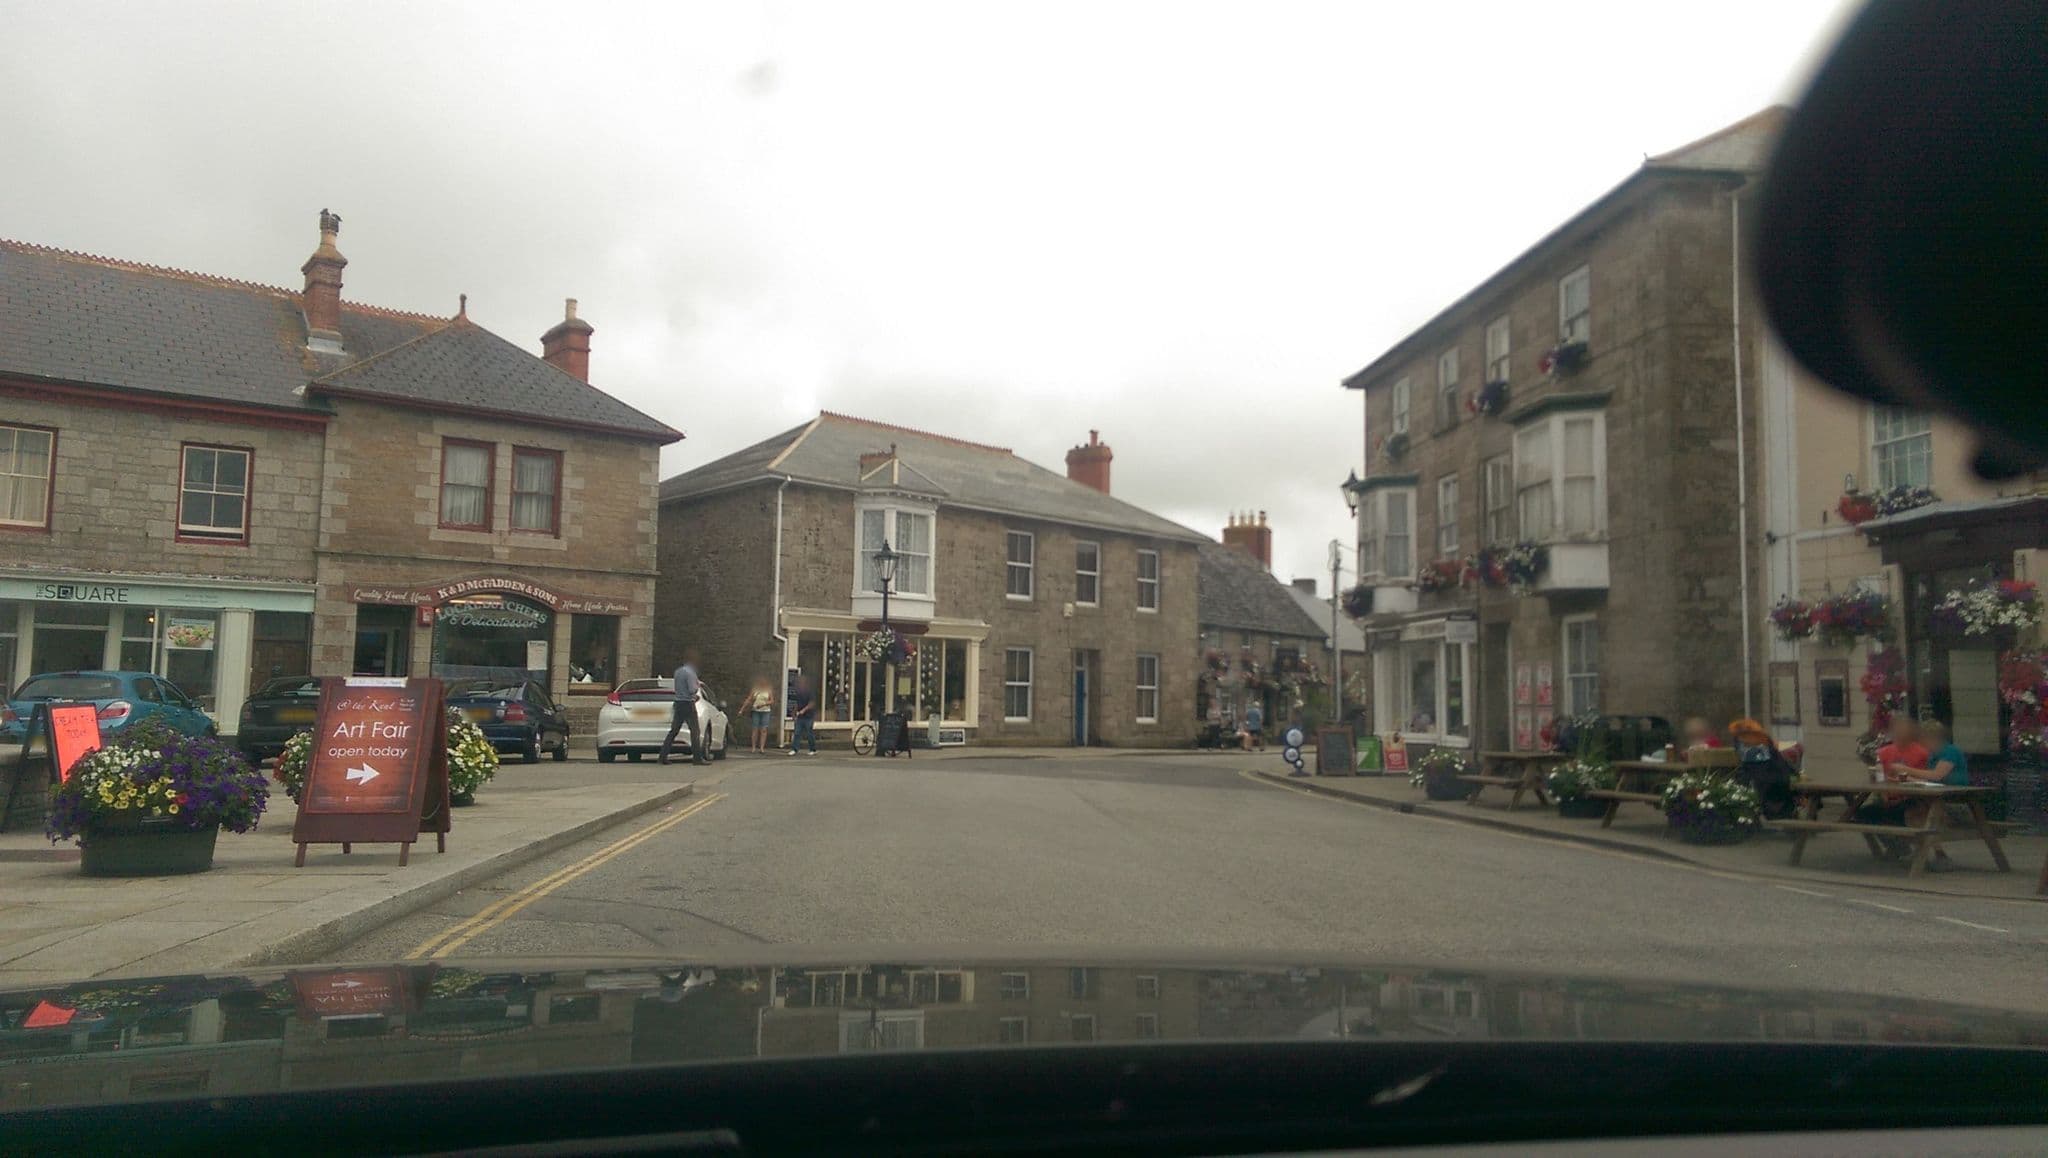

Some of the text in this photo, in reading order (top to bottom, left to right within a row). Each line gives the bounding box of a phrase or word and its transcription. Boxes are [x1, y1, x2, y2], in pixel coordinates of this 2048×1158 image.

[533, 587, 558, 605] SONS
[333, 721, 411, 739] Art Fair
[328, 746, 408, 759] open today
